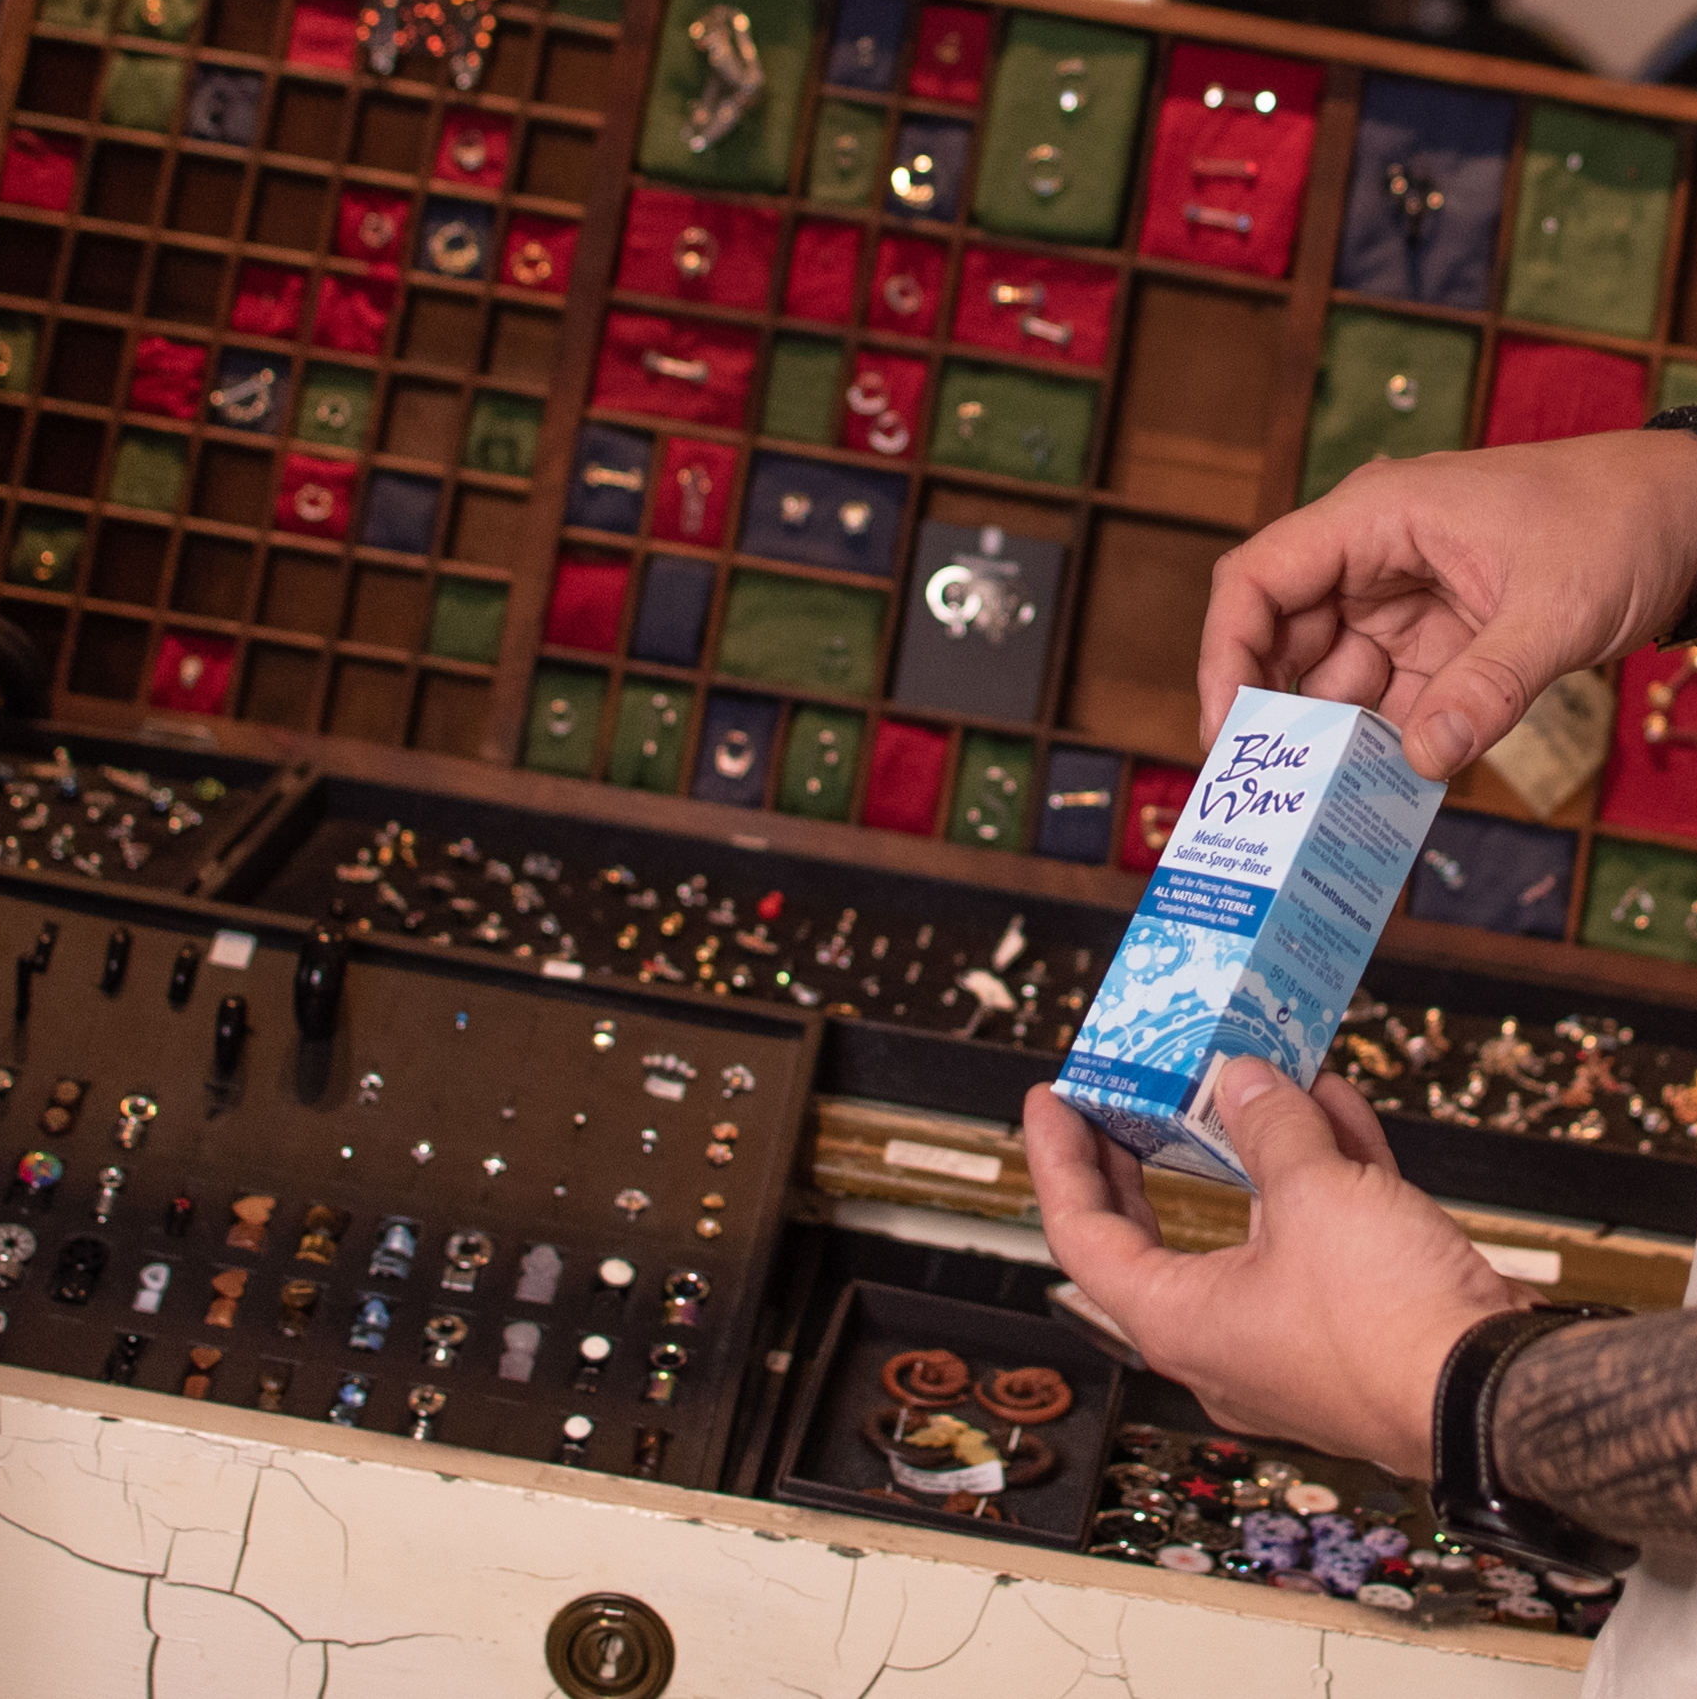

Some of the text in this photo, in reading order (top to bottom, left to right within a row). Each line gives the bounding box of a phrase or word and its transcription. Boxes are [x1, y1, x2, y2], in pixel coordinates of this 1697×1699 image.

[1215, 732, 1310, 782] Blue
[1199, 777, 1305, 825] Wave
[1191, 829, 1269, 856] Medical Grade
[1173, 845, 1273, 877] Saline Spray-Rinse
[1152, 885, 1169, 898] ALL
[1170, 888, 1211, 907] NATURAL
[1216, 898, 1257, 917] STERILE
[1195, 878, 1222, 895] Piercing
[1221, 884, 1252, 900] Aftercare
[1301, 866, 1372, 934] www.tattoogoo.com
[1156, 900, 1240, 927] Complete Cleansing Action
